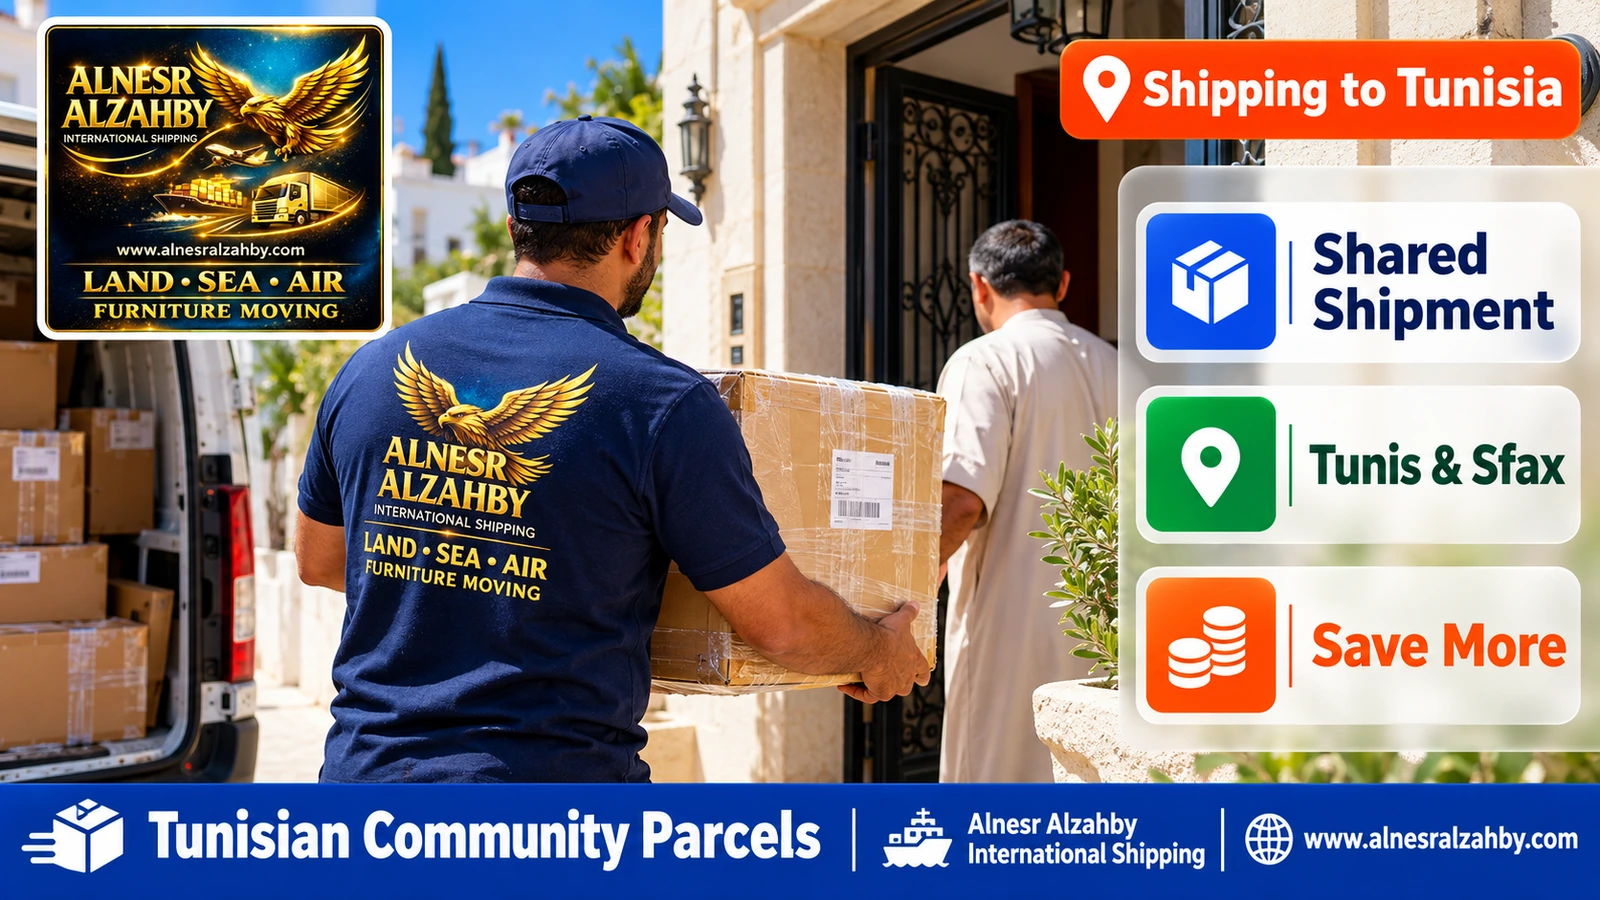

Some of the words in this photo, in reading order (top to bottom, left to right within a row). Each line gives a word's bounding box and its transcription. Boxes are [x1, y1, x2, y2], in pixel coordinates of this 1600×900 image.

[382, 436, 508, 482] ALNESR
[377, 468, 531, 519] ALZAHBY
[374, 504, 471, 529] INTERNATIONAL
[475, 519, 536, 539] SHIPPING
[364, 532, 417, 559] LAND
[435, 543, 481, 570] SEA
[502, 554, 548, 581] AIR
[365, 559, 457, 588] FURNITURE
[463, 575, 541, 601] MOVING
